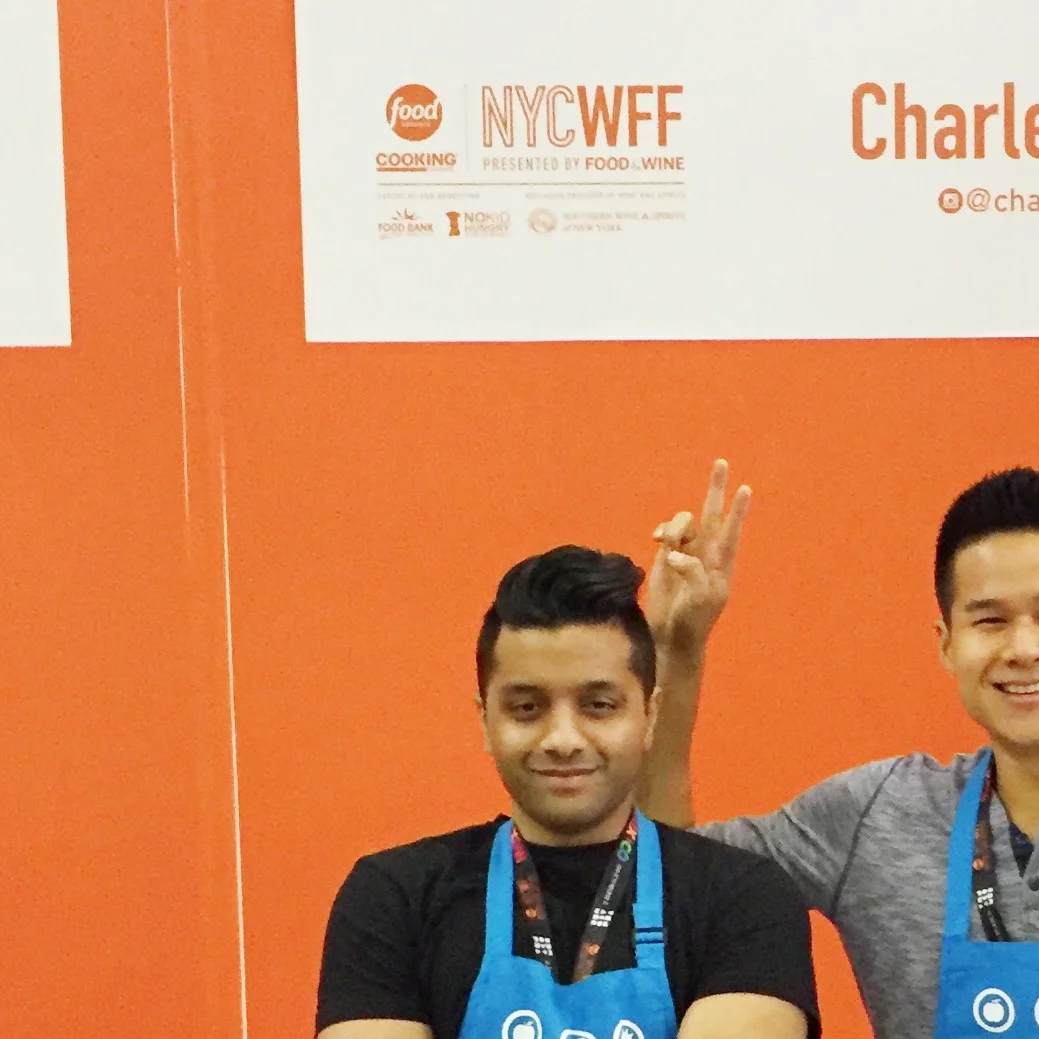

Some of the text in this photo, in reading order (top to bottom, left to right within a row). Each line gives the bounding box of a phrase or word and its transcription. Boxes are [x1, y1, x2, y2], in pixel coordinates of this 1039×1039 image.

[390, 96, 440, 128] food
[481, 84, 684, 148] NYCWFF
[375, 151, 457, 167] COOKING
[482, 156, 559, 172] PRESENTED
[563, 156, 580, 172] BY
[377, 222, 434, 233] FOOD BANK
